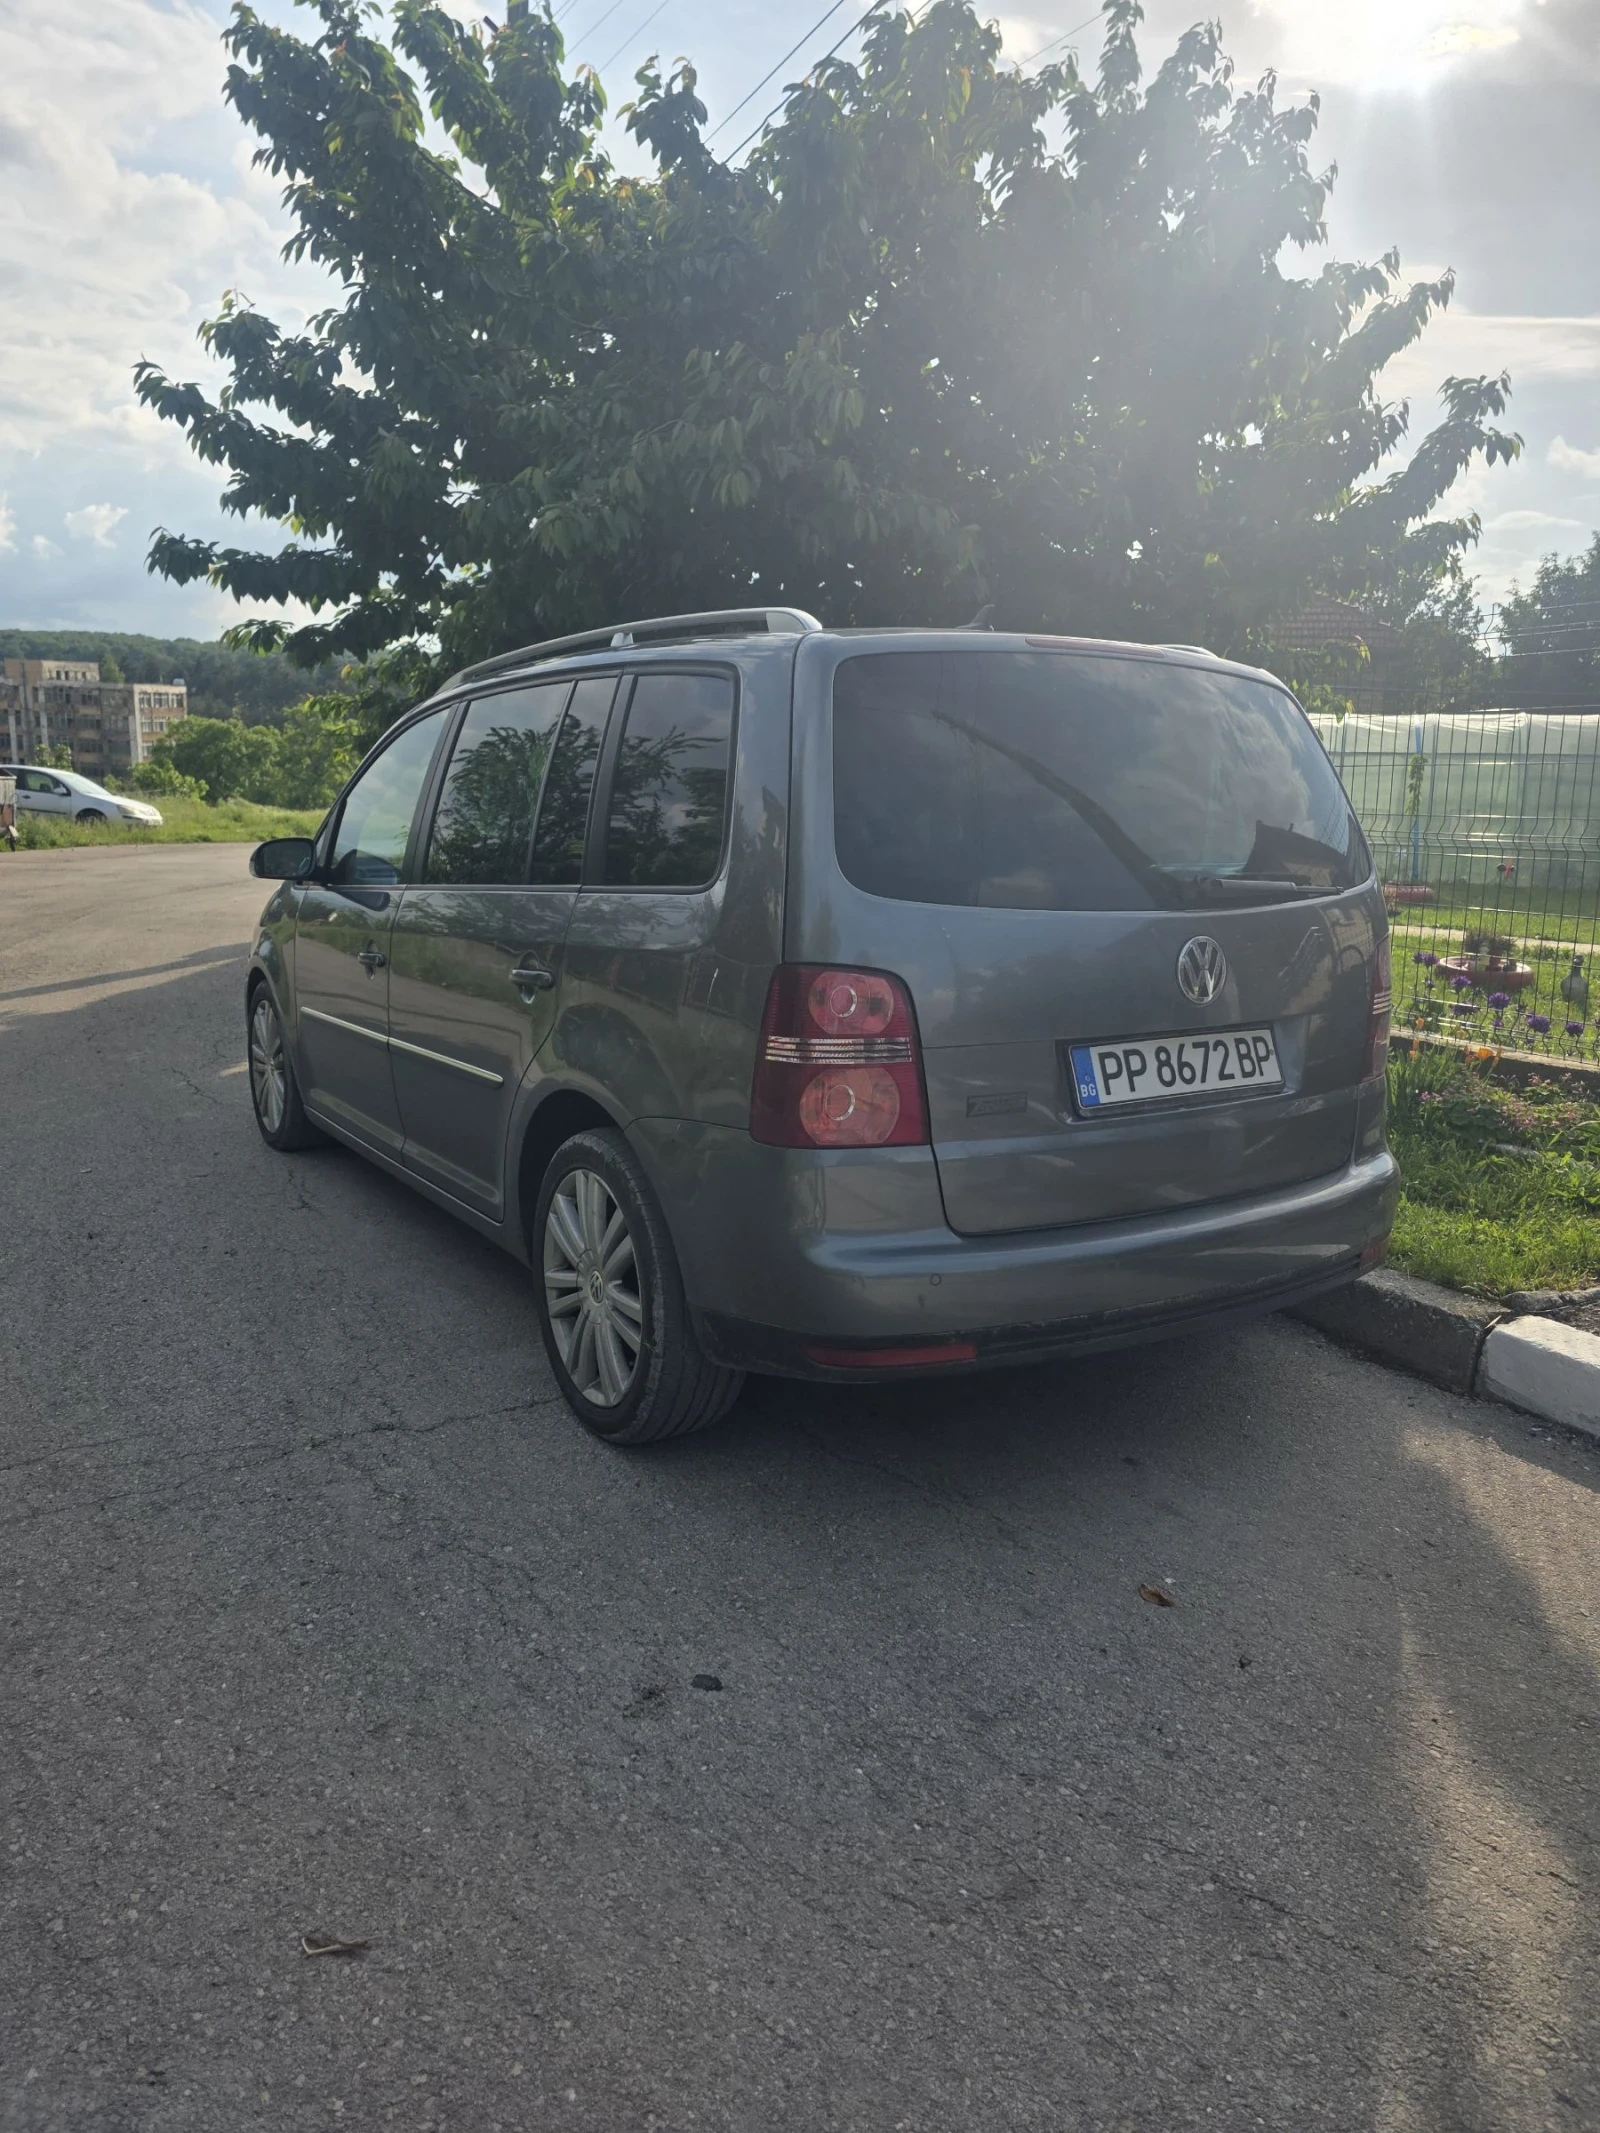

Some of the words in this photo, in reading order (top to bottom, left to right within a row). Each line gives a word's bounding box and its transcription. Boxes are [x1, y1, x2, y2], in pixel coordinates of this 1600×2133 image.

[1098, 1048, 1147, 1096] PP
[1154, 1039, 1236, 1088] 8672
[1233, 1036, 1270, 1079] BP
[1080, 1083, 1097, 1098] BG
